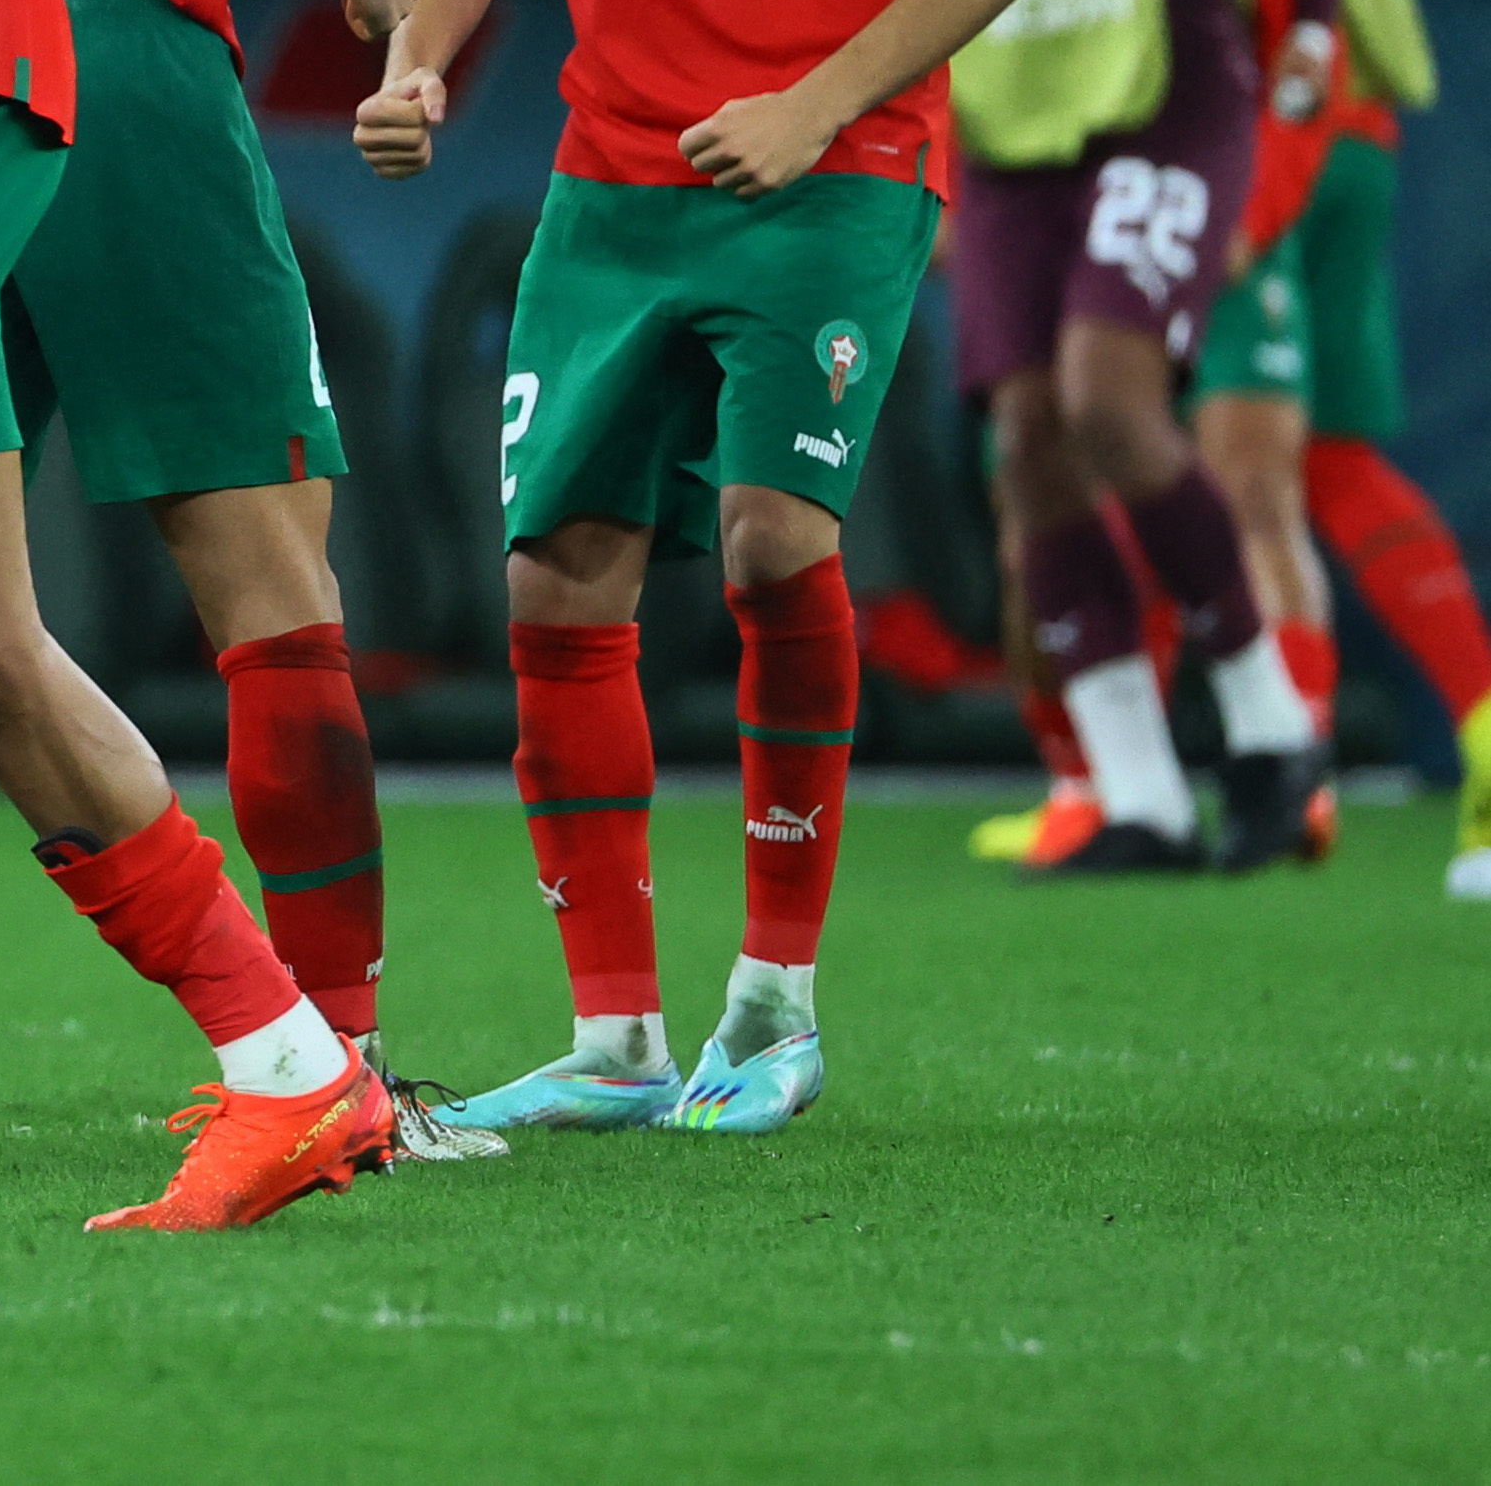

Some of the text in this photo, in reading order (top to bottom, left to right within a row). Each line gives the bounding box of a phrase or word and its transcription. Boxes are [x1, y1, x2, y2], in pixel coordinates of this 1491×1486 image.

[1086, 154, 1212, 282] 22
[500, 371, 541, 508] 2
[794, 431, 843, 469] PUMA
[746, 818, 804, 842] PUMA
[282, 1099, 350, 1164] ULTRA
